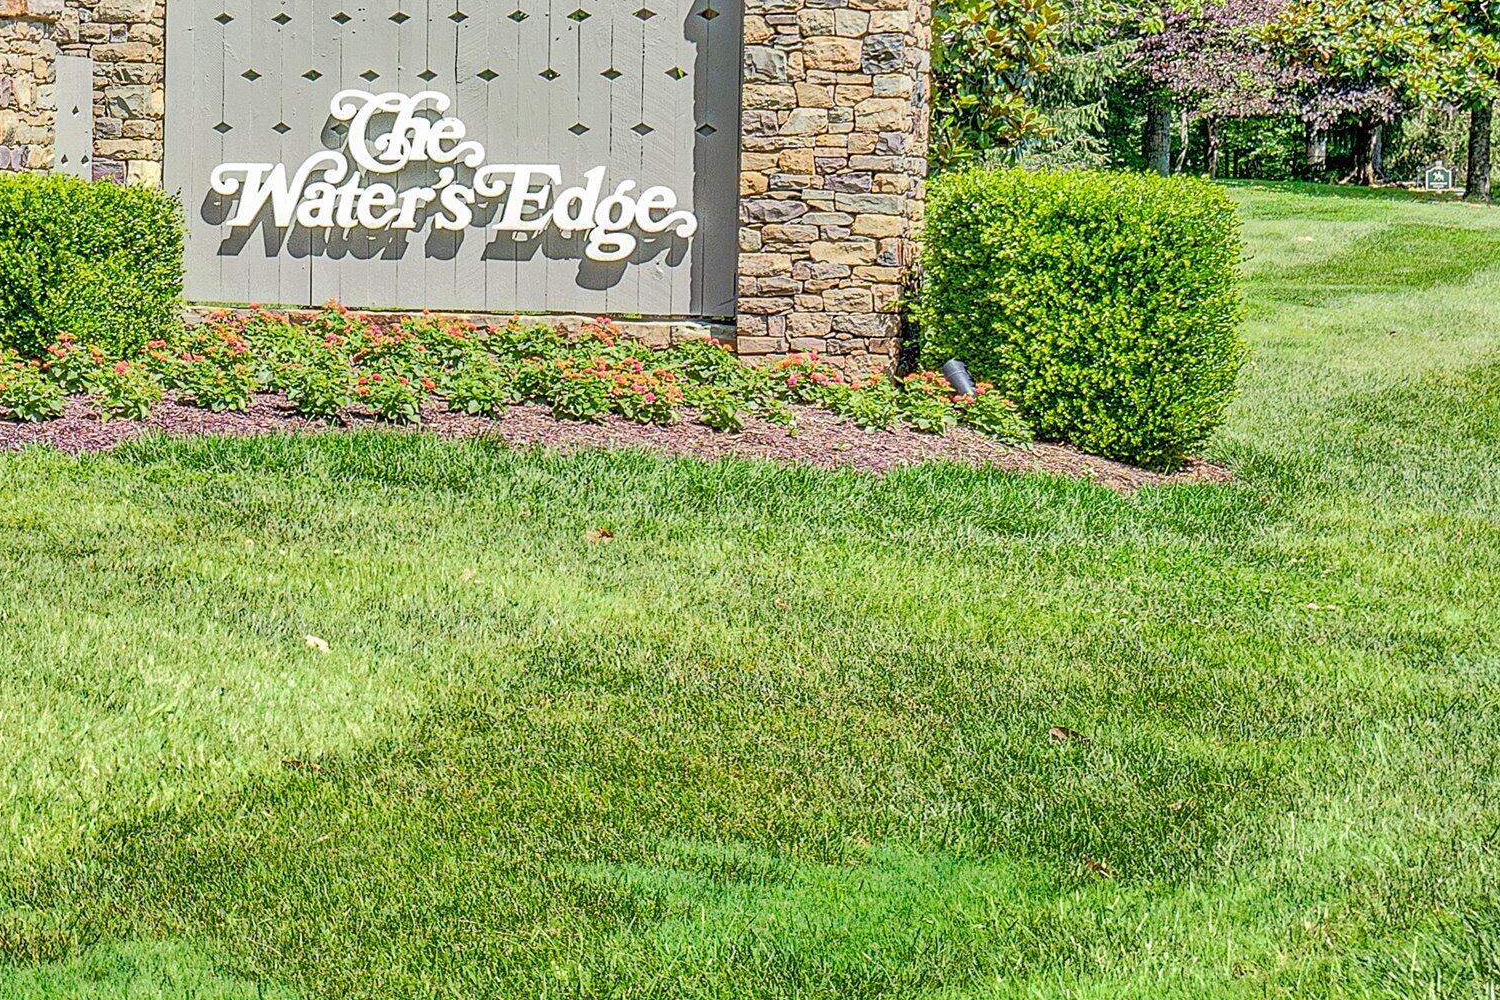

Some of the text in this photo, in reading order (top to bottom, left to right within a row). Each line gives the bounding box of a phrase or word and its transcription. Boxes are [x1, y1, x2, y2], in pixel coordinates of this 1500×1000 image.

[330, 88, 485, 173] The
[209, 150, 698, 261] Water's Edge
